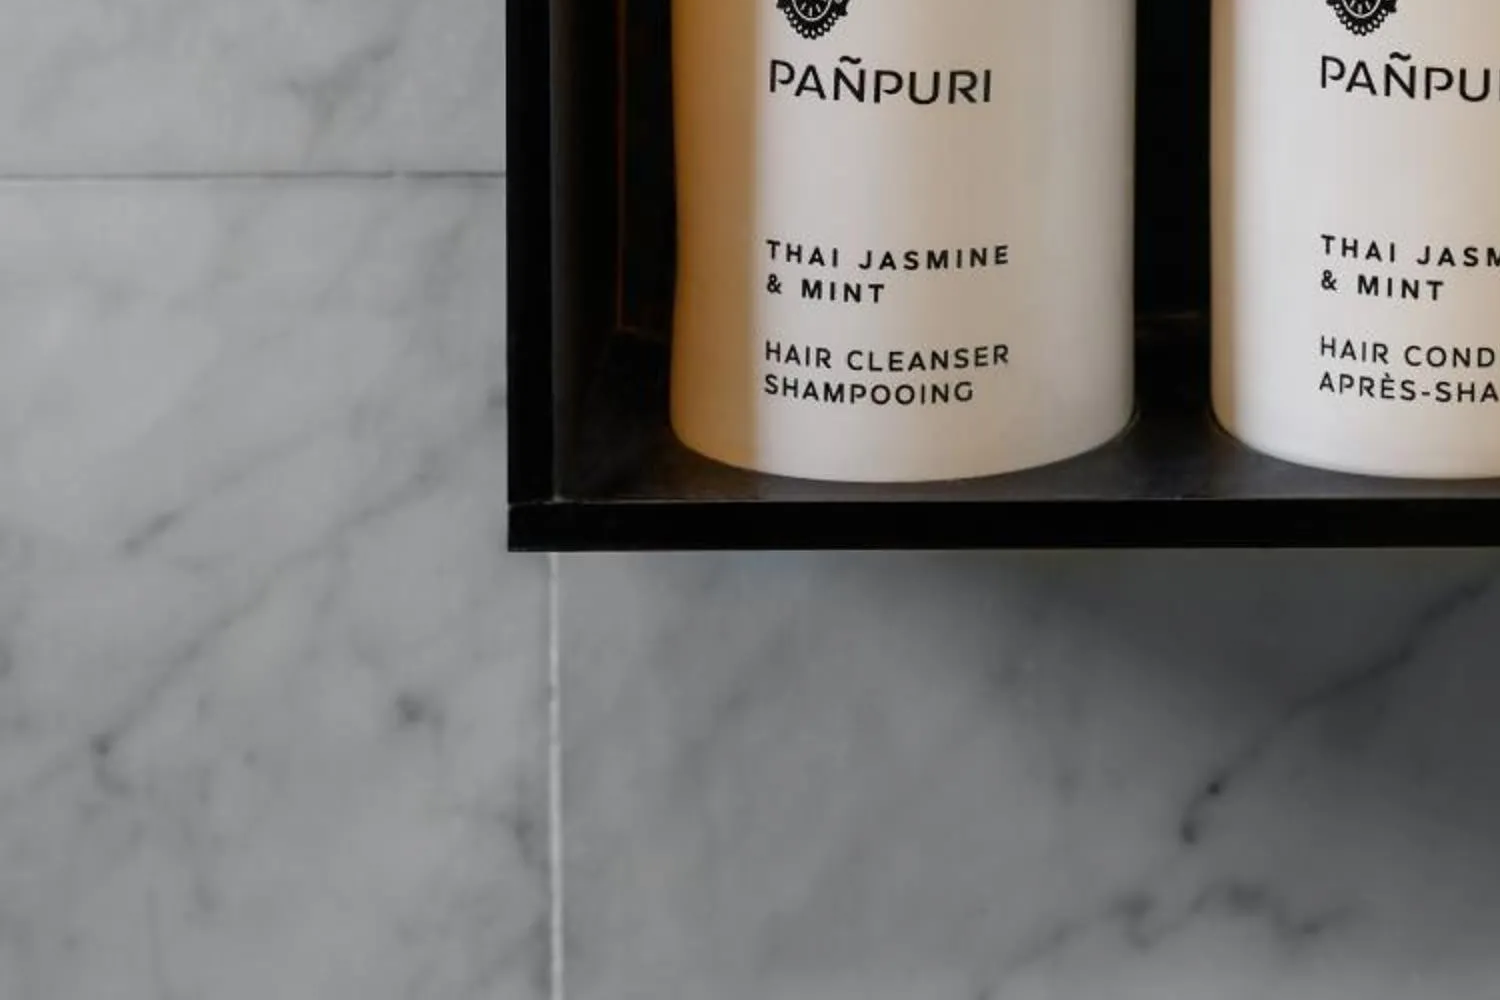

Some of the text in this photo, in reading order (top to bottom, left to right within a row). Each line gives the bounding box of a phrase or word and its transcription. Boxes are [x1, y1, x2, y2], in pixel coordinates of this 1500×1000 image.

[769, 54, 992, 106] PAÑPURI
[766, 239, 1010, 271] THAI JASMINE
[1320, 234, 1396, 263] THAI
[766, 273, 885, 304] & MINT
[1321, 269, 1445, 302] & MINT
[765, 340, 1009, 373] HAIR CLEANSER
[1319, 335, 1390, 365] HAIR
[764, 373, 974, 406] SHAMPOOING
